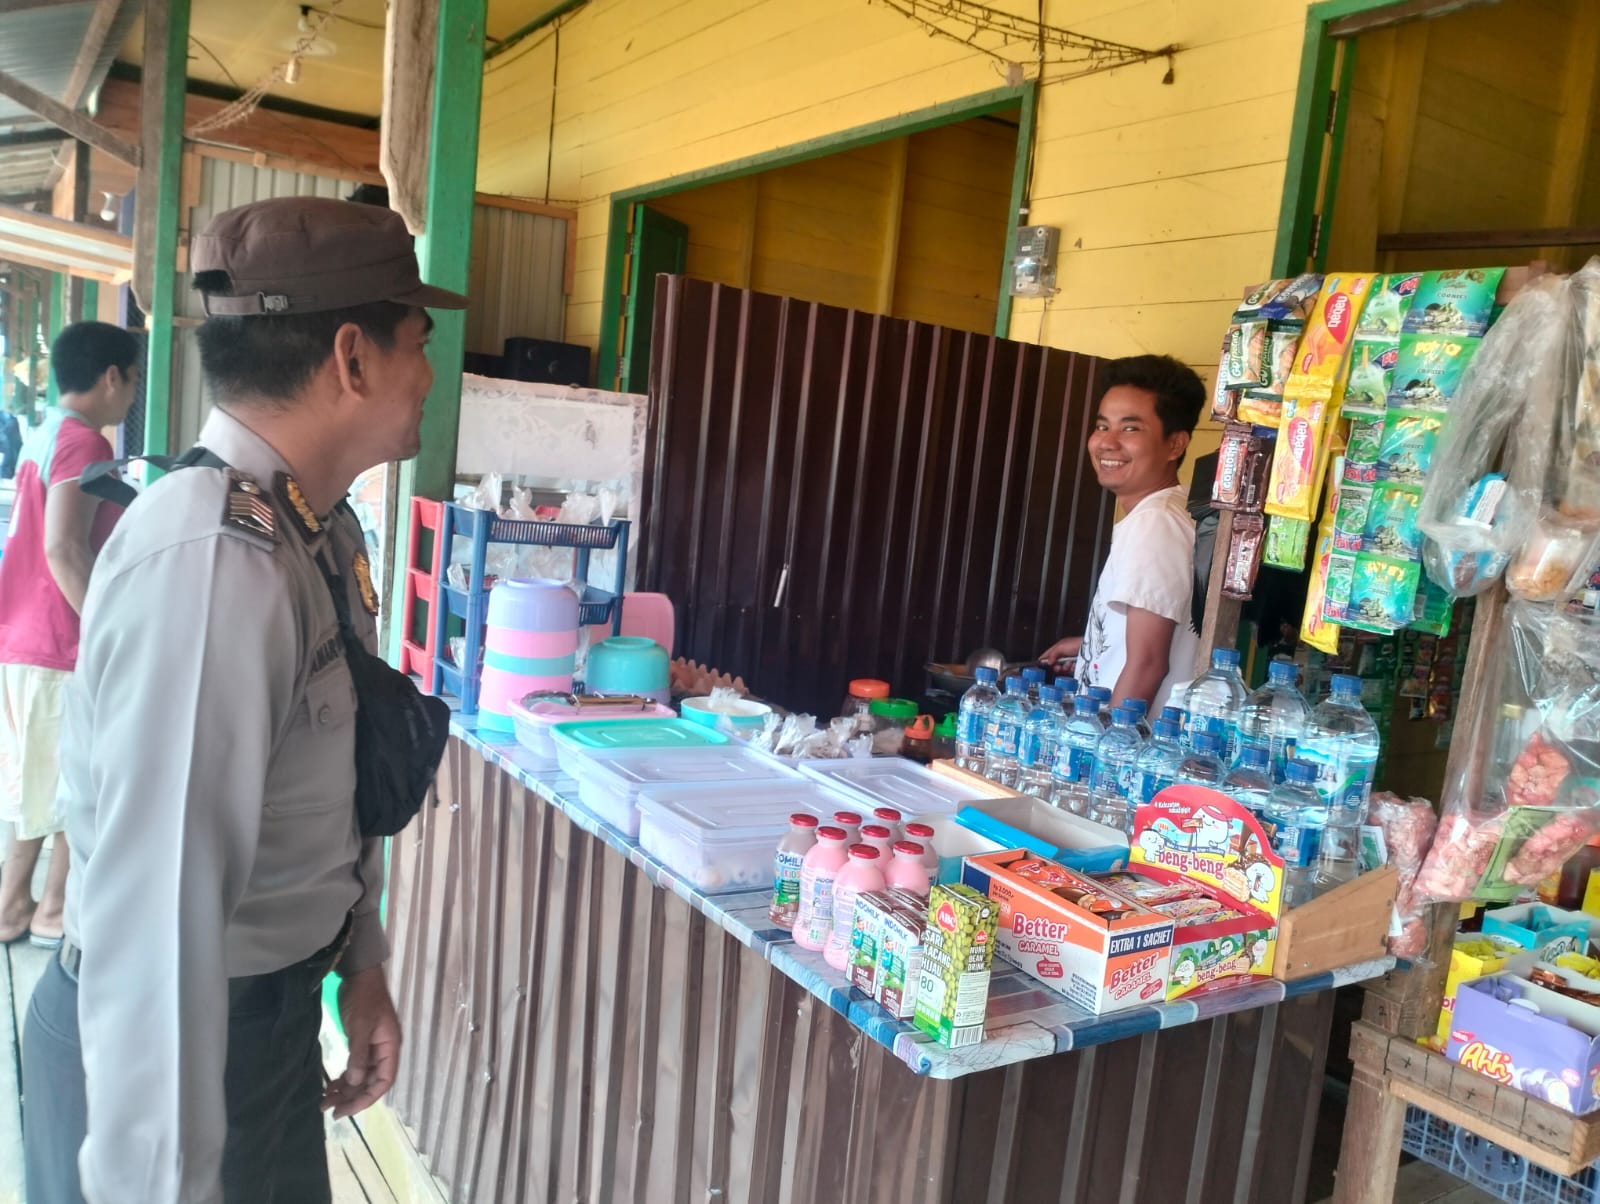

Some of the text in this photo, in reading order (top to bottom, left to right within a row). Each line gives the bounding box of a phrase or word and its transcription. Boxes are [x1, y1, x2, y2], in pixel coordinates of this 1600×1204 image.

[1327, 295, 1348, 328] nabati
[1158, 851, 1225, 881] beng-beng
[855, 898, 880, 921] INDOMILK
[938, 910, 957, 929] ABC
[884, 917, 908, 940] INDOMILK
[925, 930, 944, 948] SARI
[1012, 914, 1067, 940] Better
[1018, 940, 1060, 956] CARAMEL
[1110, 929, 1172, 955] EXTRA 1 SACHET
[921, 956, 943, 977] HIJAU
[923, 943, 951, 969] KACANG
[1109, 953, 1158, 990] Better
[1196, 958, 1238, 984] beng-beng
[920, 975, 934, 993] 80
